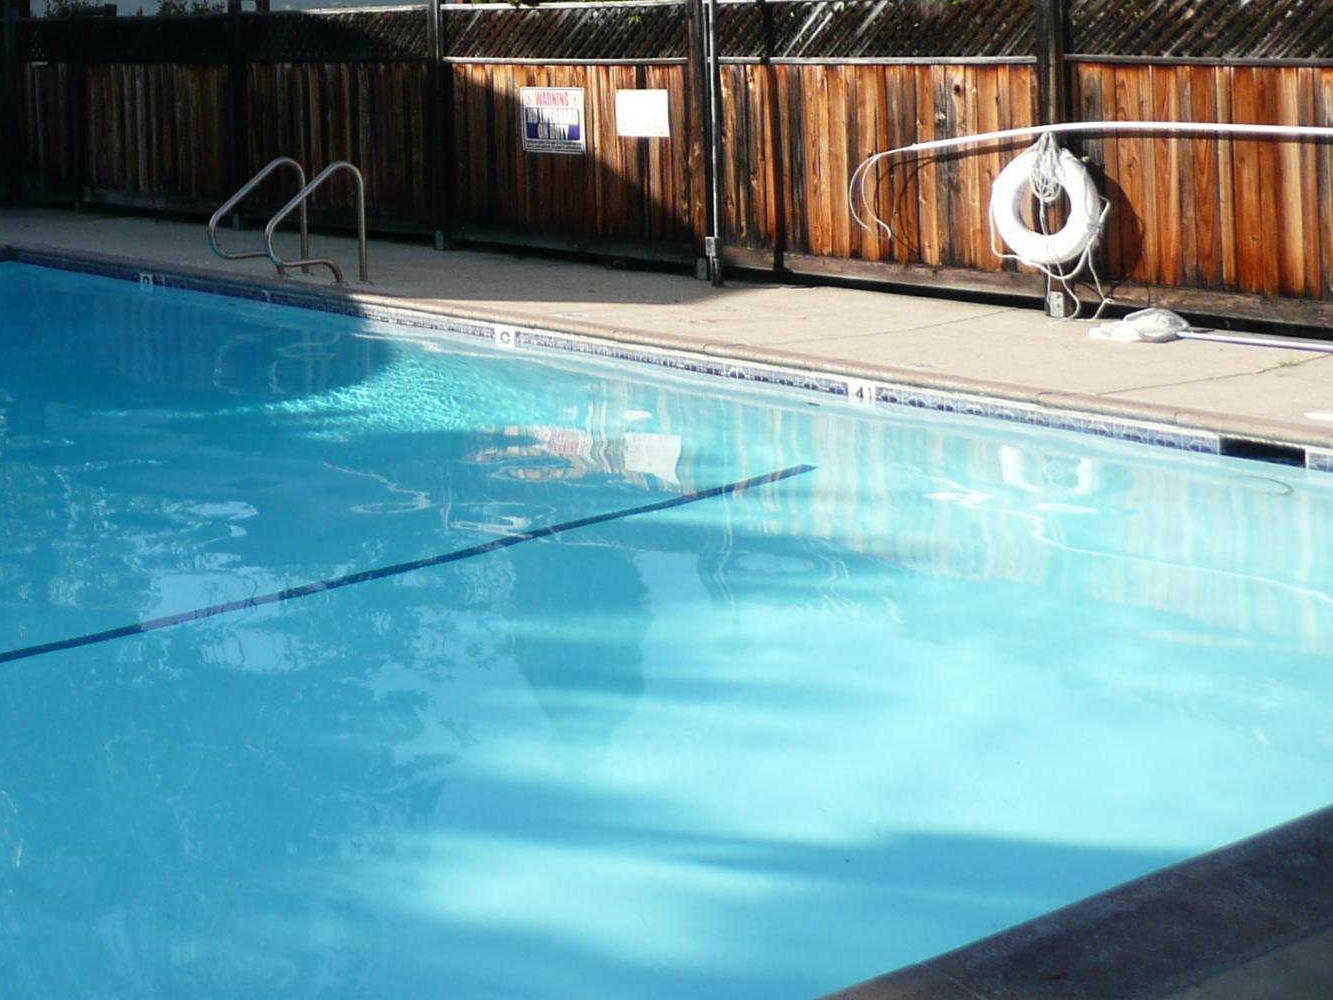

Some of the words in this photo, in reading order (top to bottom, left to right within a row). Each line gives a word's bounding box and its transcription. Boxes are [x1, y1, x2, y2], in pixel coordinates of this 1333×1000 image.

[535, 91, 569, 106] WARNING
[538, 123, 548, 139] ON
[550, 124, 570, 140] DUTY
